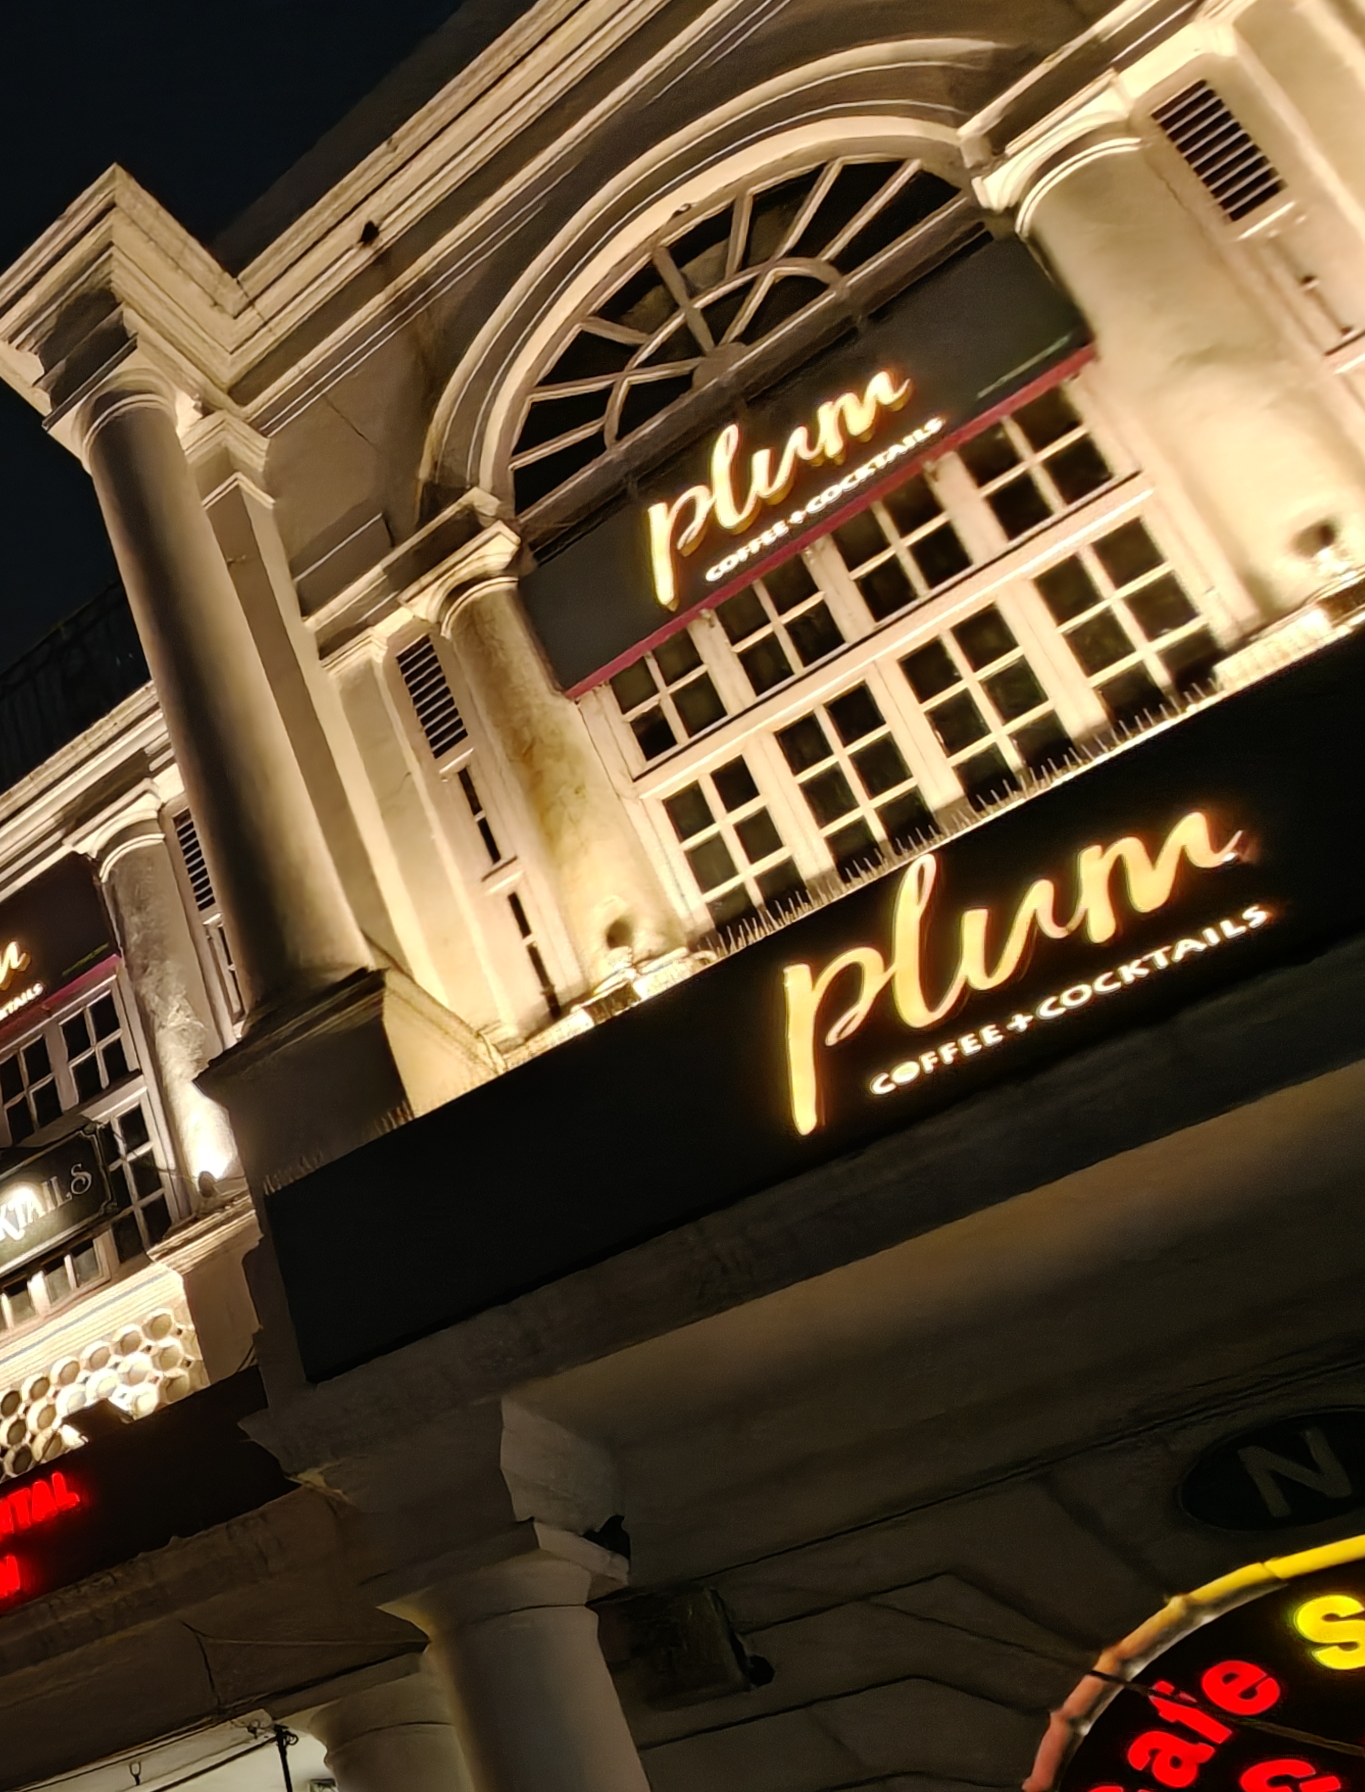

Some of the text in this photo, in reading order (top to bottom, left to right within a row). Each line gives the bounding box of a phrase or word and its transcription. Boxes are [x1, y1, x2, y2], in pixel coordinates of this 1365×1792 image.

[648, 371, 912, 608] plum
[705, 520, 790, 582] COFFEE
[806, 416, 946, 514] COCKTAILS
[784, 812, 1245, 1136] plum
[869, 1023, 1005, 1096] COFFEE
[1035, 904, 1272, 1021] COCKTAILS
